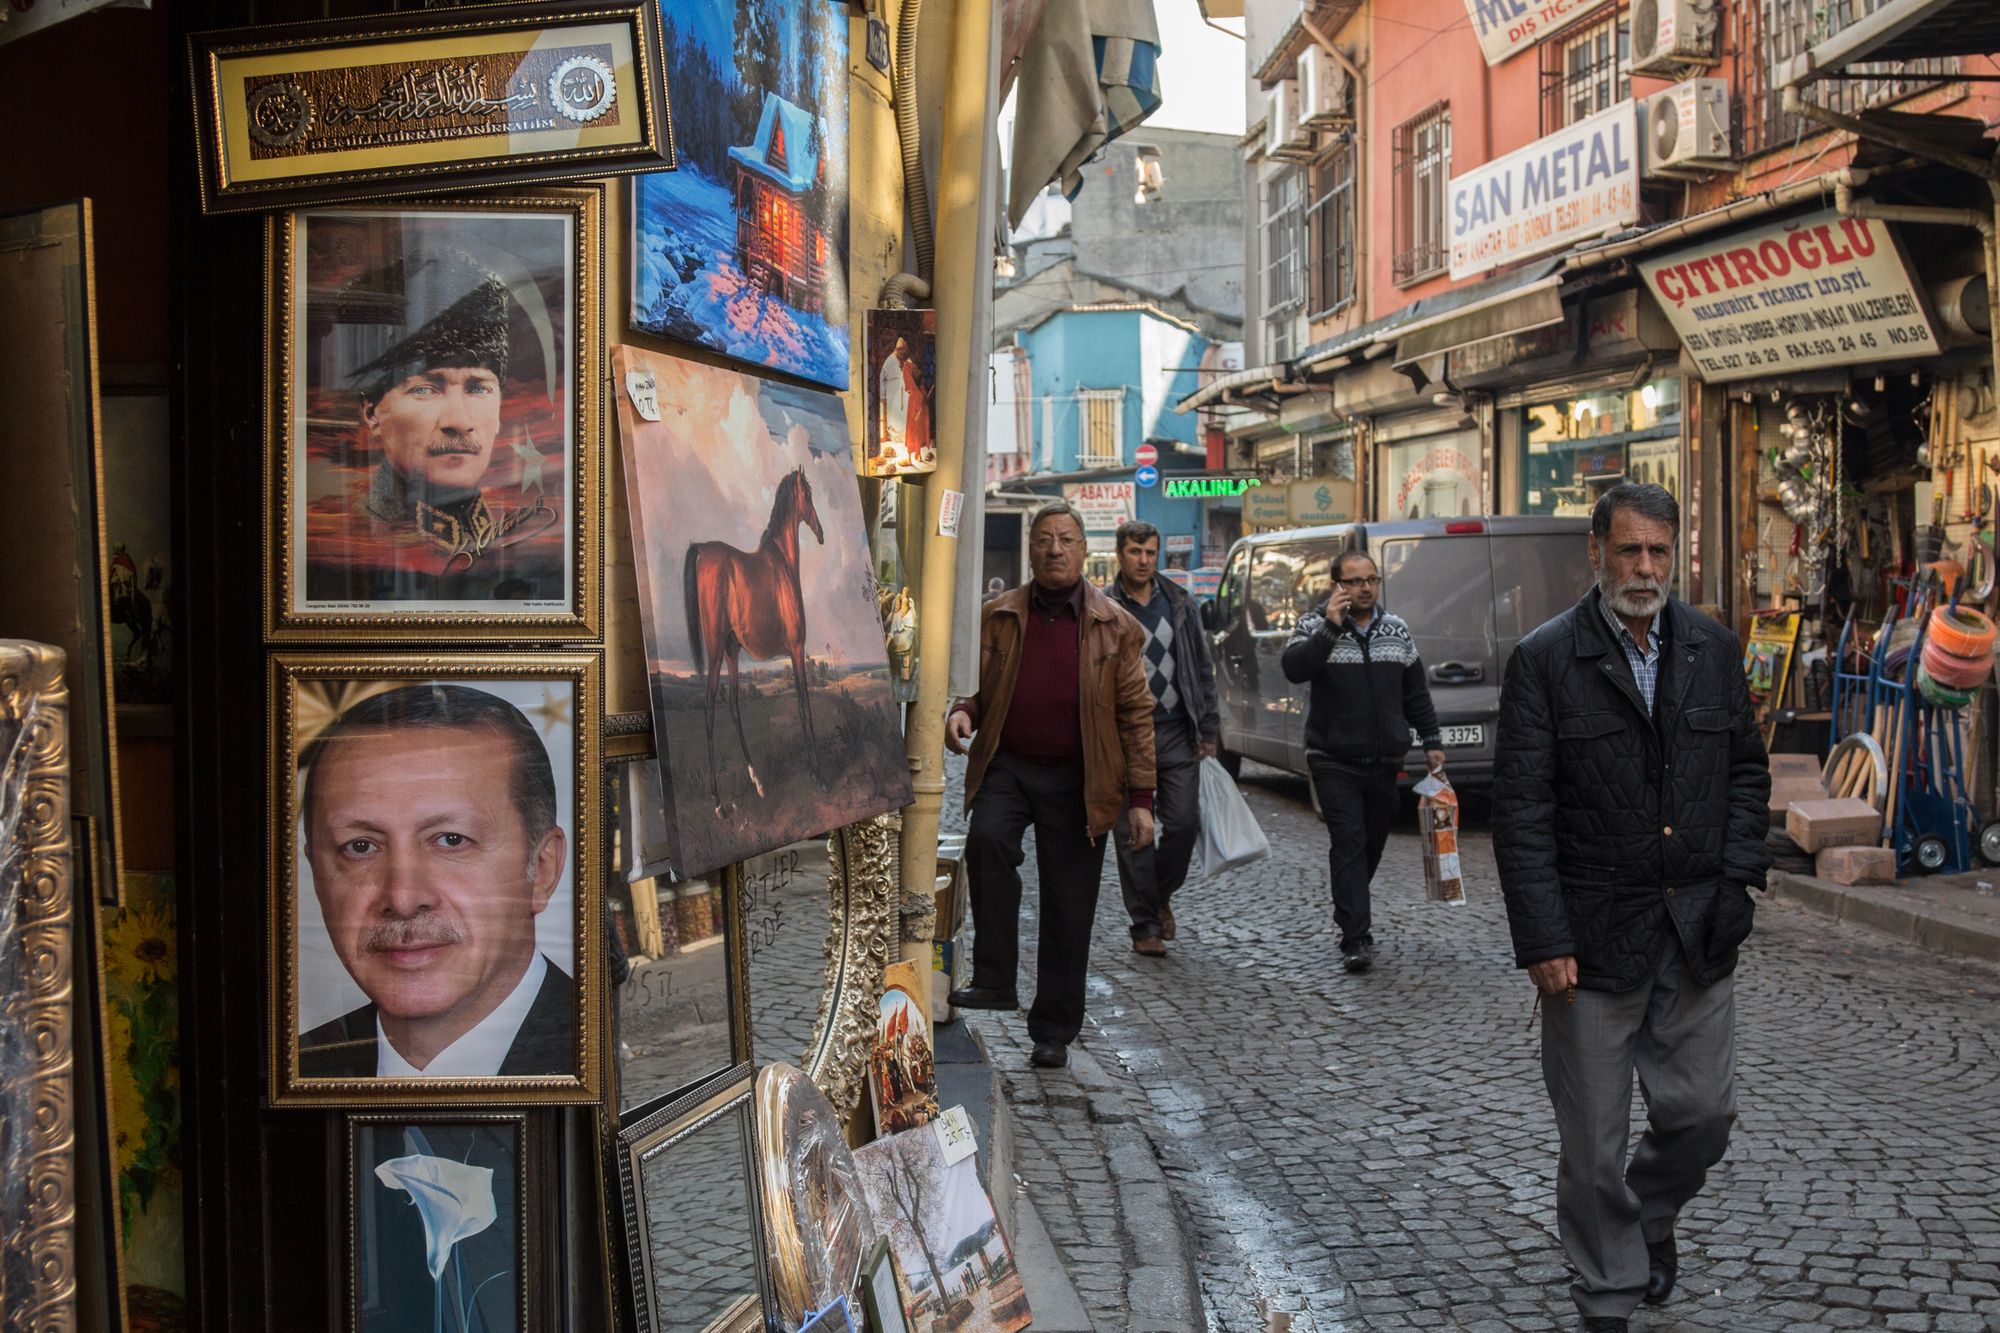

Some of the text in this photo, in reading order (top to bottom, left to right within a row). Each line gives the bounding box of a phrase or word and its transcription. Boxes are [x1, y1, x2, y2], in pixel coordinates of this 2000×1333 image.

[1508, 18, 1537, 43] DIŞ
[1455, 122, 1630, 236] SAN METAL
[1655, 219, 1876, 309] ÇITIROĞLU
[1693, 293, 1759, 322] NALBURİYE
[1759, 283, 1812, 307] TİCARET
[1851, 289, 1919, 325] MALZEMELERİ
[1699, 324, 1930, 374] TEL:527 26 29 FAX:513 24 45 NO.98
[1079, 483, 1132, 499] ABAYLAR
[1449, 727, 1480, 743] 3375
